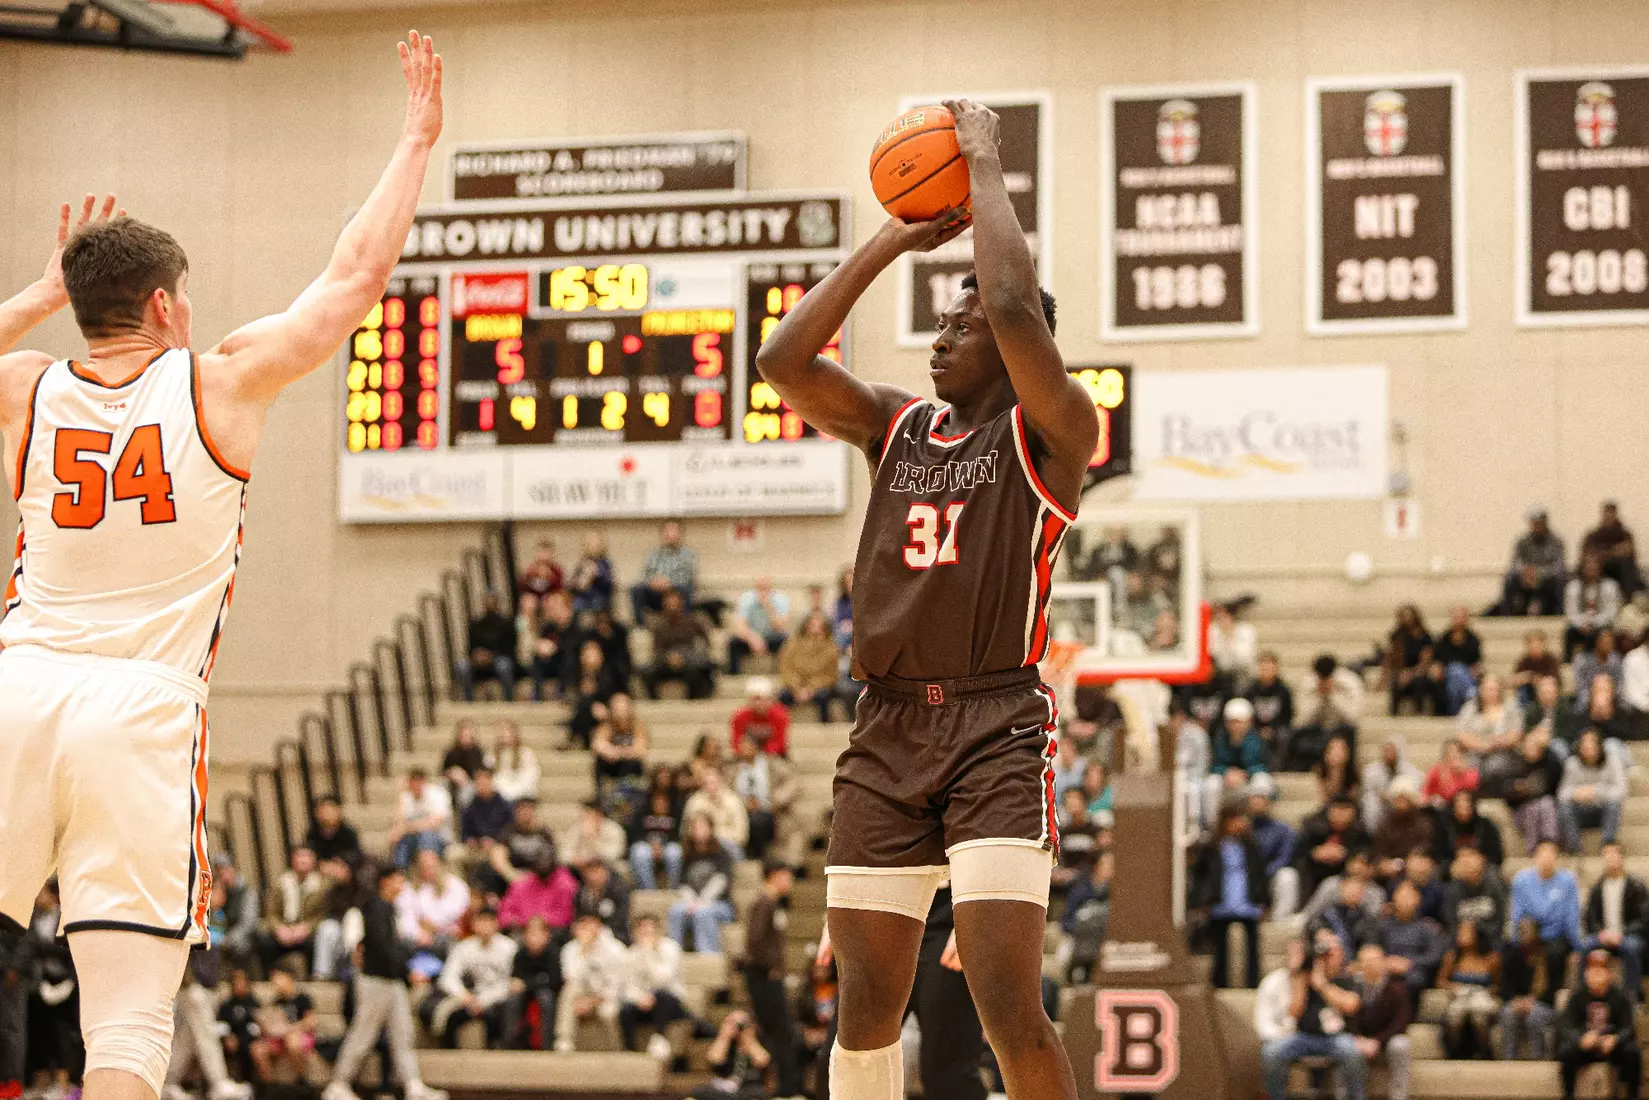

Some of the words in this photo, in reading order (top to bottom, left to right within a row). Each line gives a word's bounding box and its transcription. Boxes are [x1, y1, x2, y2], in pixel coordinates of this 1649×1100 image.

[554, 207, 792, 252] UNIVERSITY
[1354, 193, 1420, 239] NIT
[1563, 184, 1631, 232] CBI
[550, 263, 649, 313] 15:50
[1336, 256, 1439, 303] 2003
[494, 337, 525, 385] 5
[588, 340, 604, 376] 1
[692, 331, 723, 380] 5
[51, 423, 176, 530] 54
[902, 501, 967, 570] 31
[927, 684, 944, 705] B
[1095, 989, 1180, 1092] B
